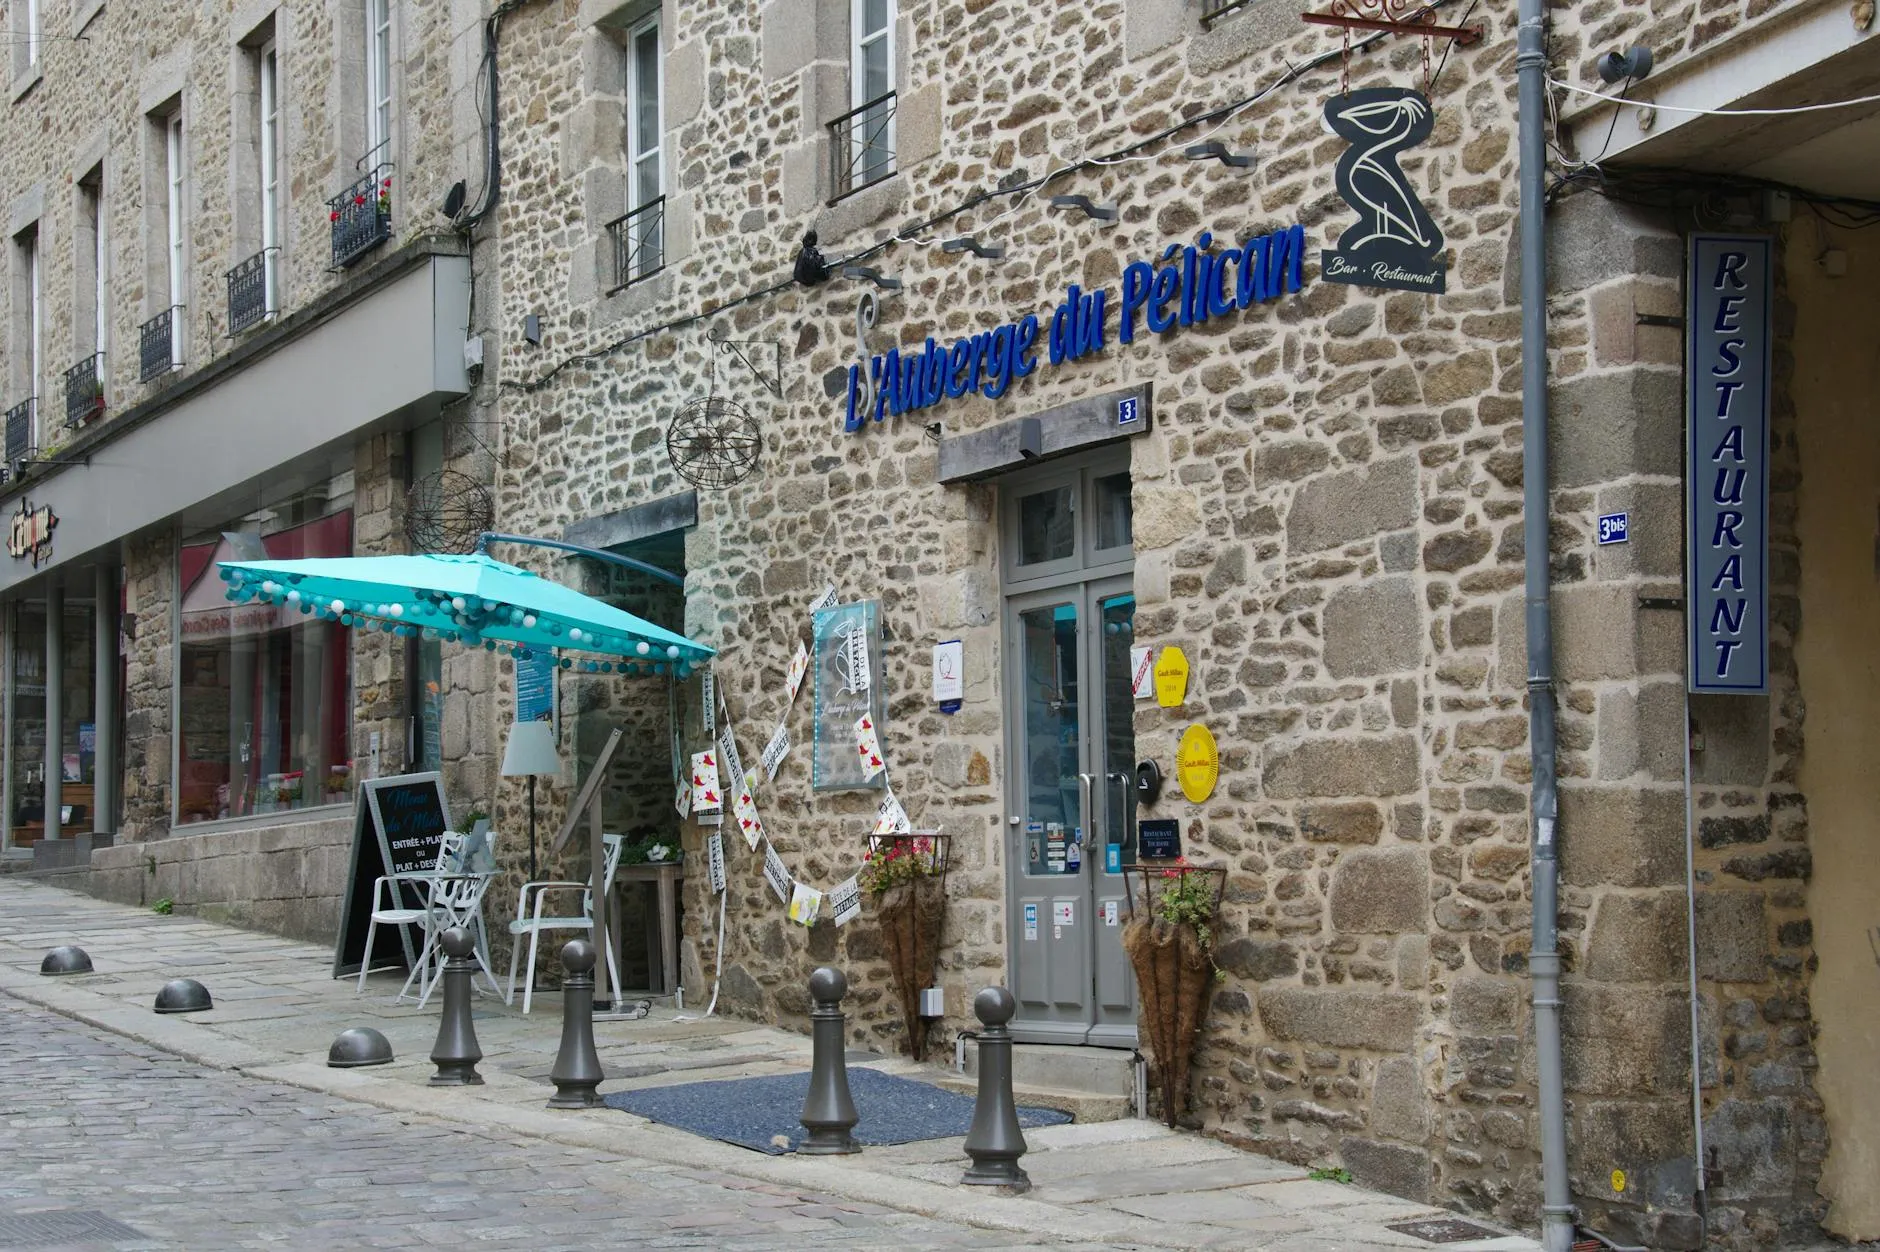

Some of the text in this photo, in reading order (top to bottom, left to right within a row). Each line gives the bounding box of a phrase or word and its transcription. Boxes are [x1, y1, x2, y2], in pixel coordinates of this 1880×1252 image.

[1326, 256, 1442, 284] Bar Restaurant
[845, 224, 1305, 432] L'Auberge du Pélican
[1124, 402, 1131, 419] 3
[1709, 251, 1748, 678] RESTAURANT
[1601, 518, 1625, 540] 3bis
[392, 836, 420, 850] ENTRÉE
[416, 850, 426, 858] OU
[396, 861, 413, 873] PLAT
